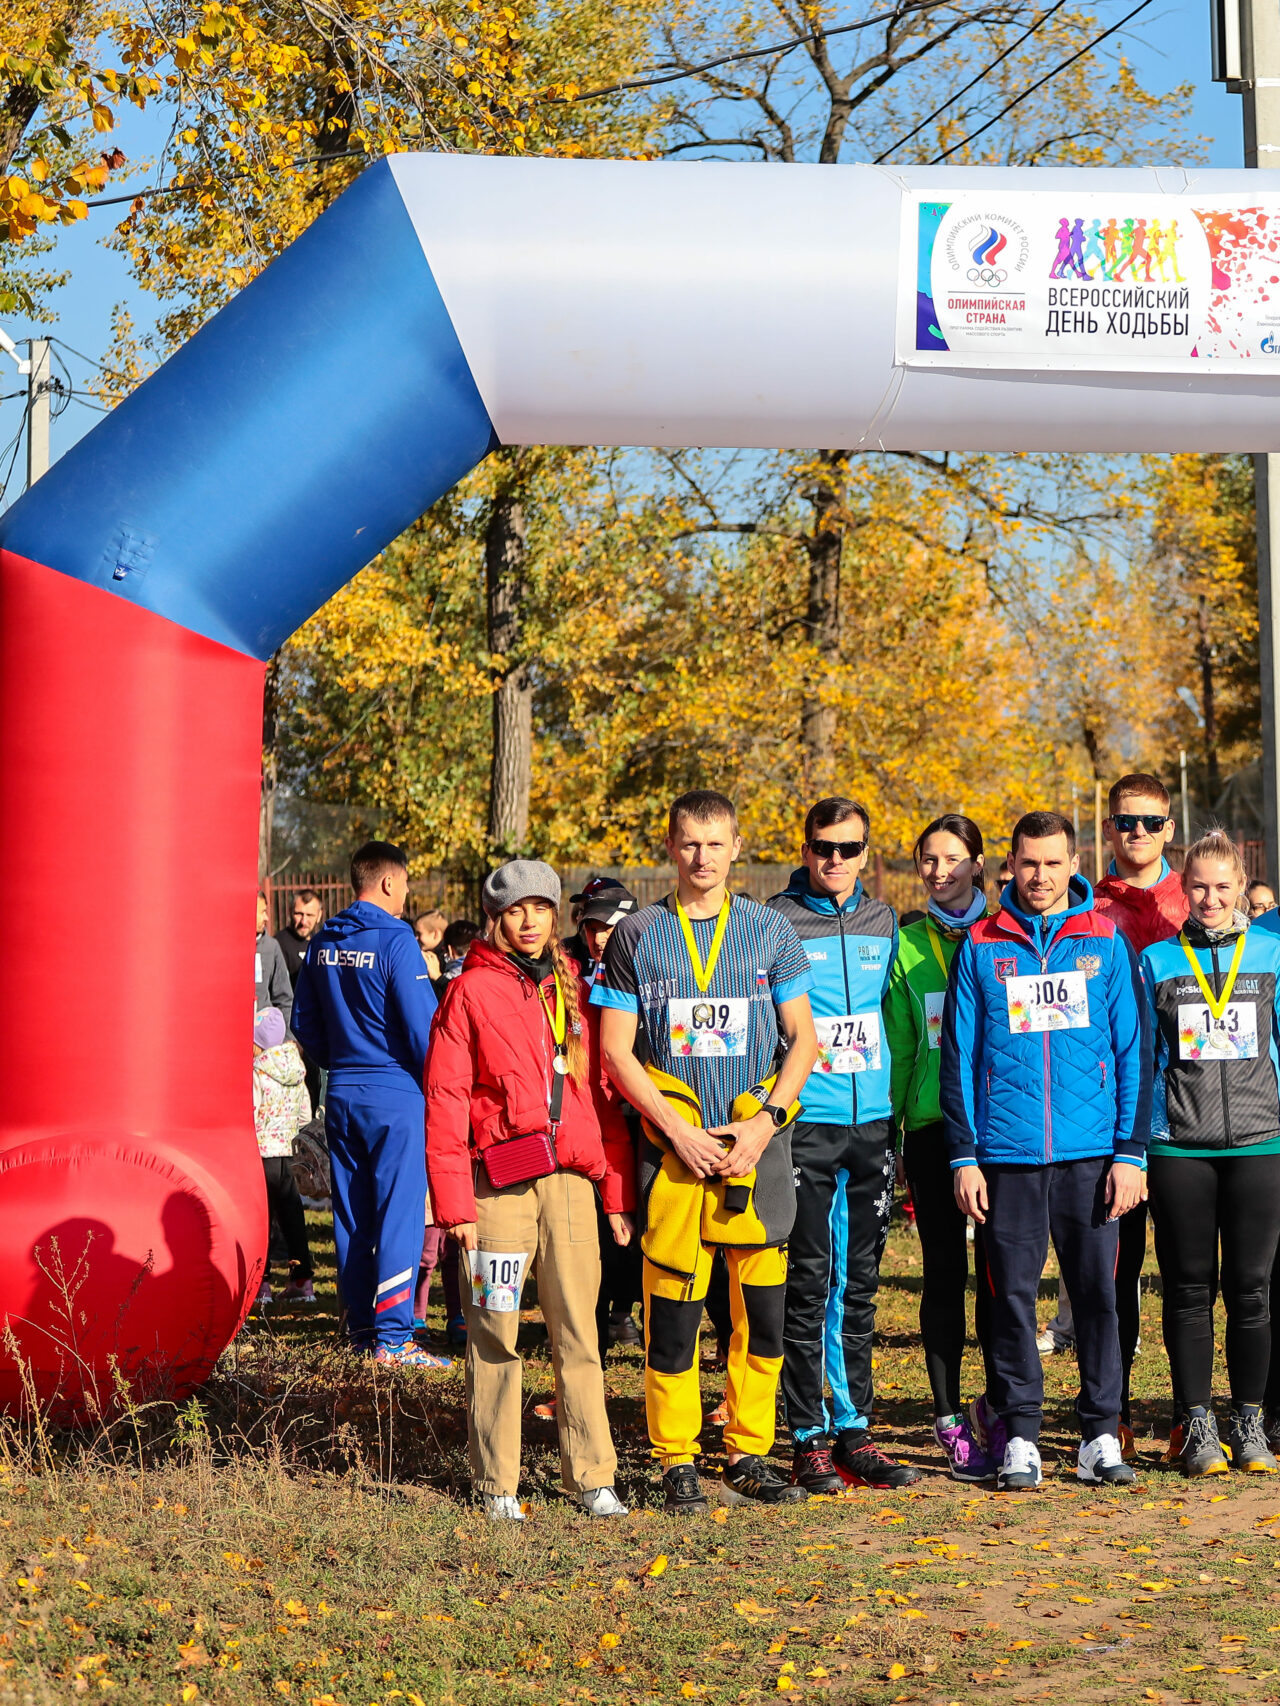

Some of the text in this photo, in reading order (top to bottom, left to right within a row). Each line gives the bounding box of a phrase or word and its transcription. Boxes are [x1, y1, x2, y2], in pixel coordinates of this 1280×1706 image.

[984, 213, 1024, 235] КОМИТЕТ
[1014, 235, 1030, 272] РОССИИ
[947, 296, 1026, 311] ОЛИМПИЙСКАЯ
[1048, 286, 1189, 309] ВСЕРОССИЙСКИЙ
[966, 312, 1006, 324] СТРАНА
[1045, 310, 1189, 339] ДЕНЬ ХОДЬБЫ
[317, 949, 375, 969] RUSSIA
[831, 1021, 867, 1047] 274
[489, 1259, 519, 1284] 109
